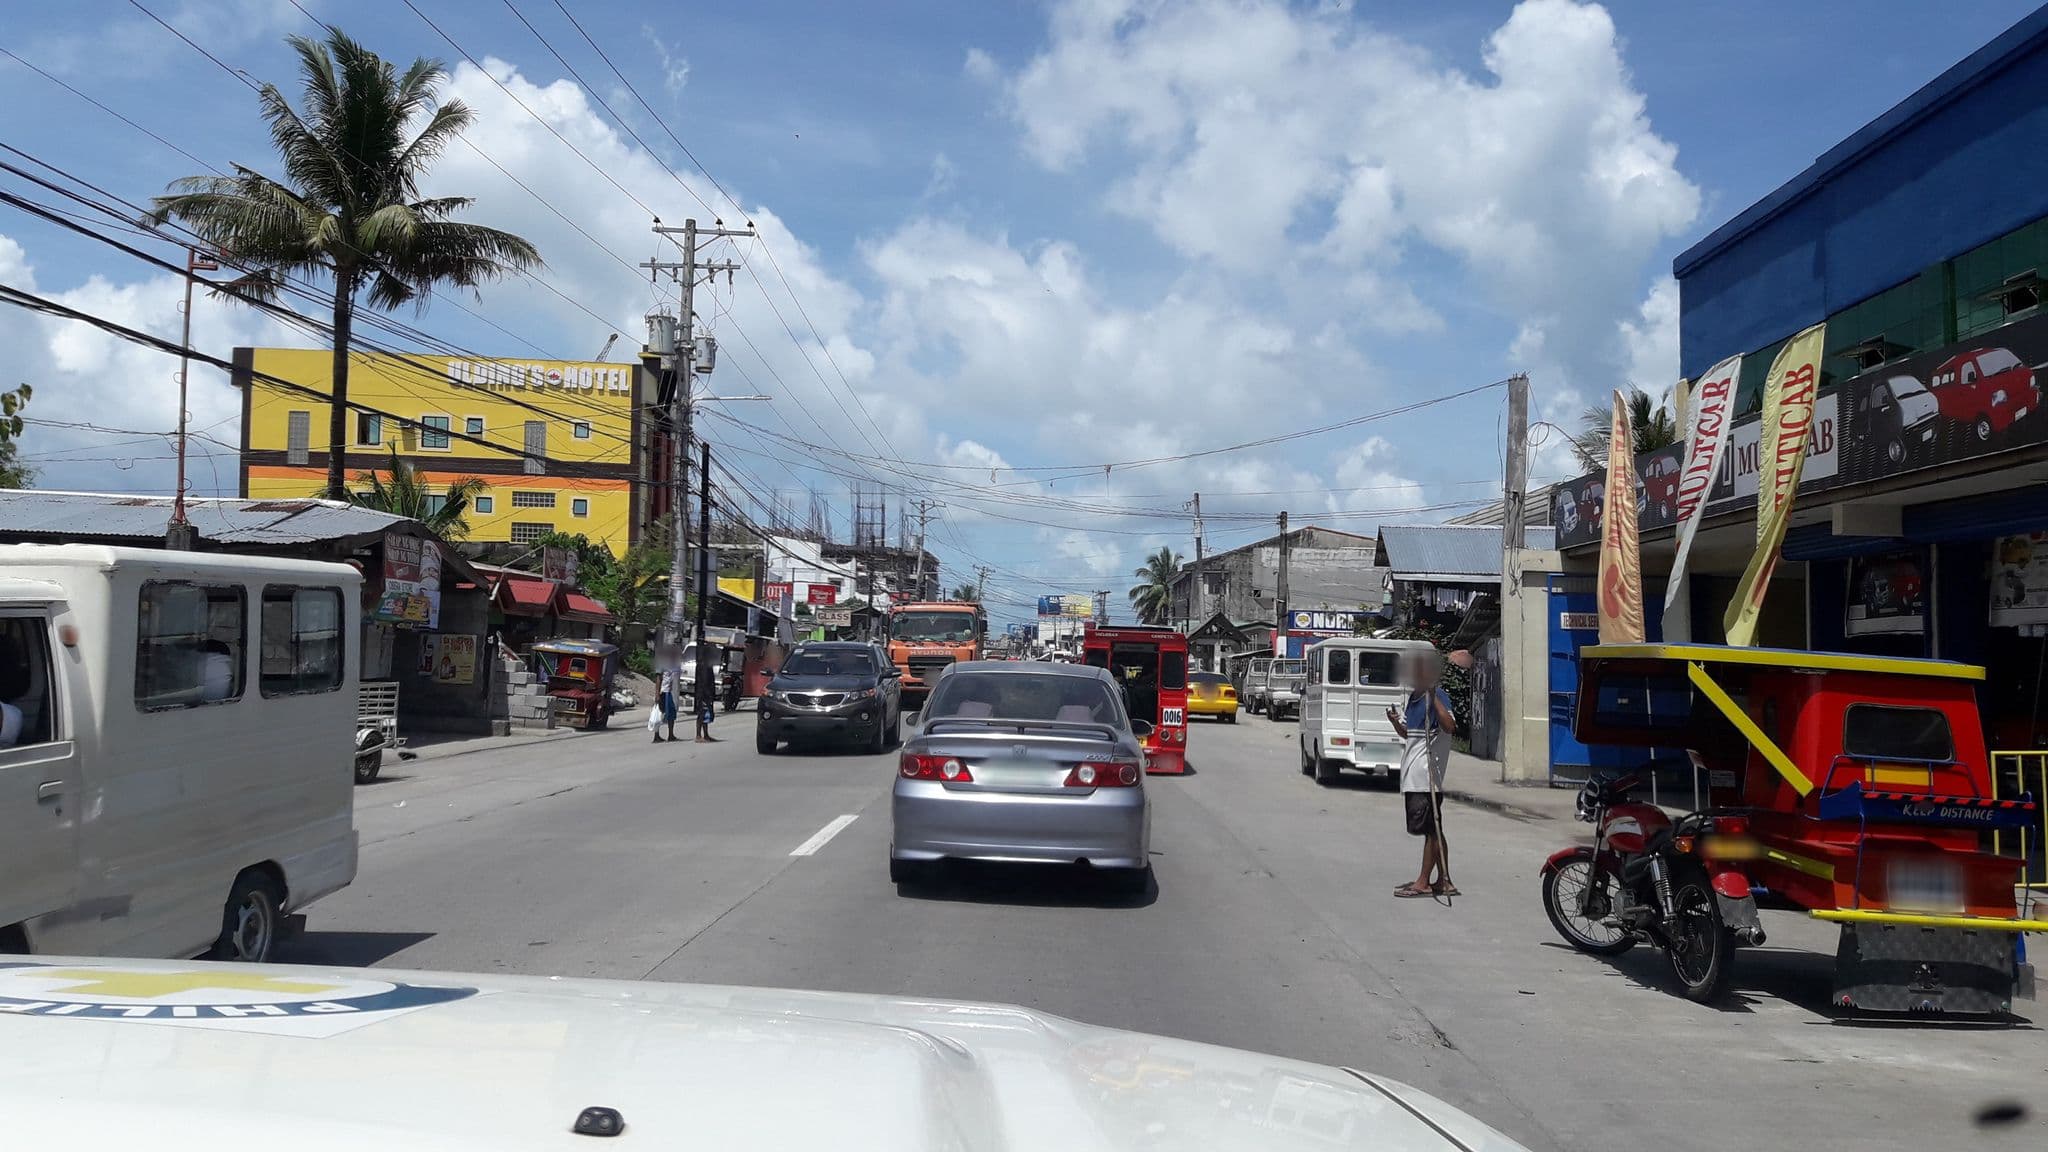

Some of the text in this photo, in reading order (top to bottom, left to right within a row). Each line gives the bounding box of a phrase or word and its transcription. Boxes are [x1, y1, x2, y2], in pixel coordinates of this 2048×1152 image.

[563, 366, 630, 391] HOTEL
[1738, 417, 1833, 478] MUAB
[817, 612, 849, 621] GLASS
[1164, 710, 1182, 723] 0016
[1902, 804, 1995, 820] KEEP DISTANCE
